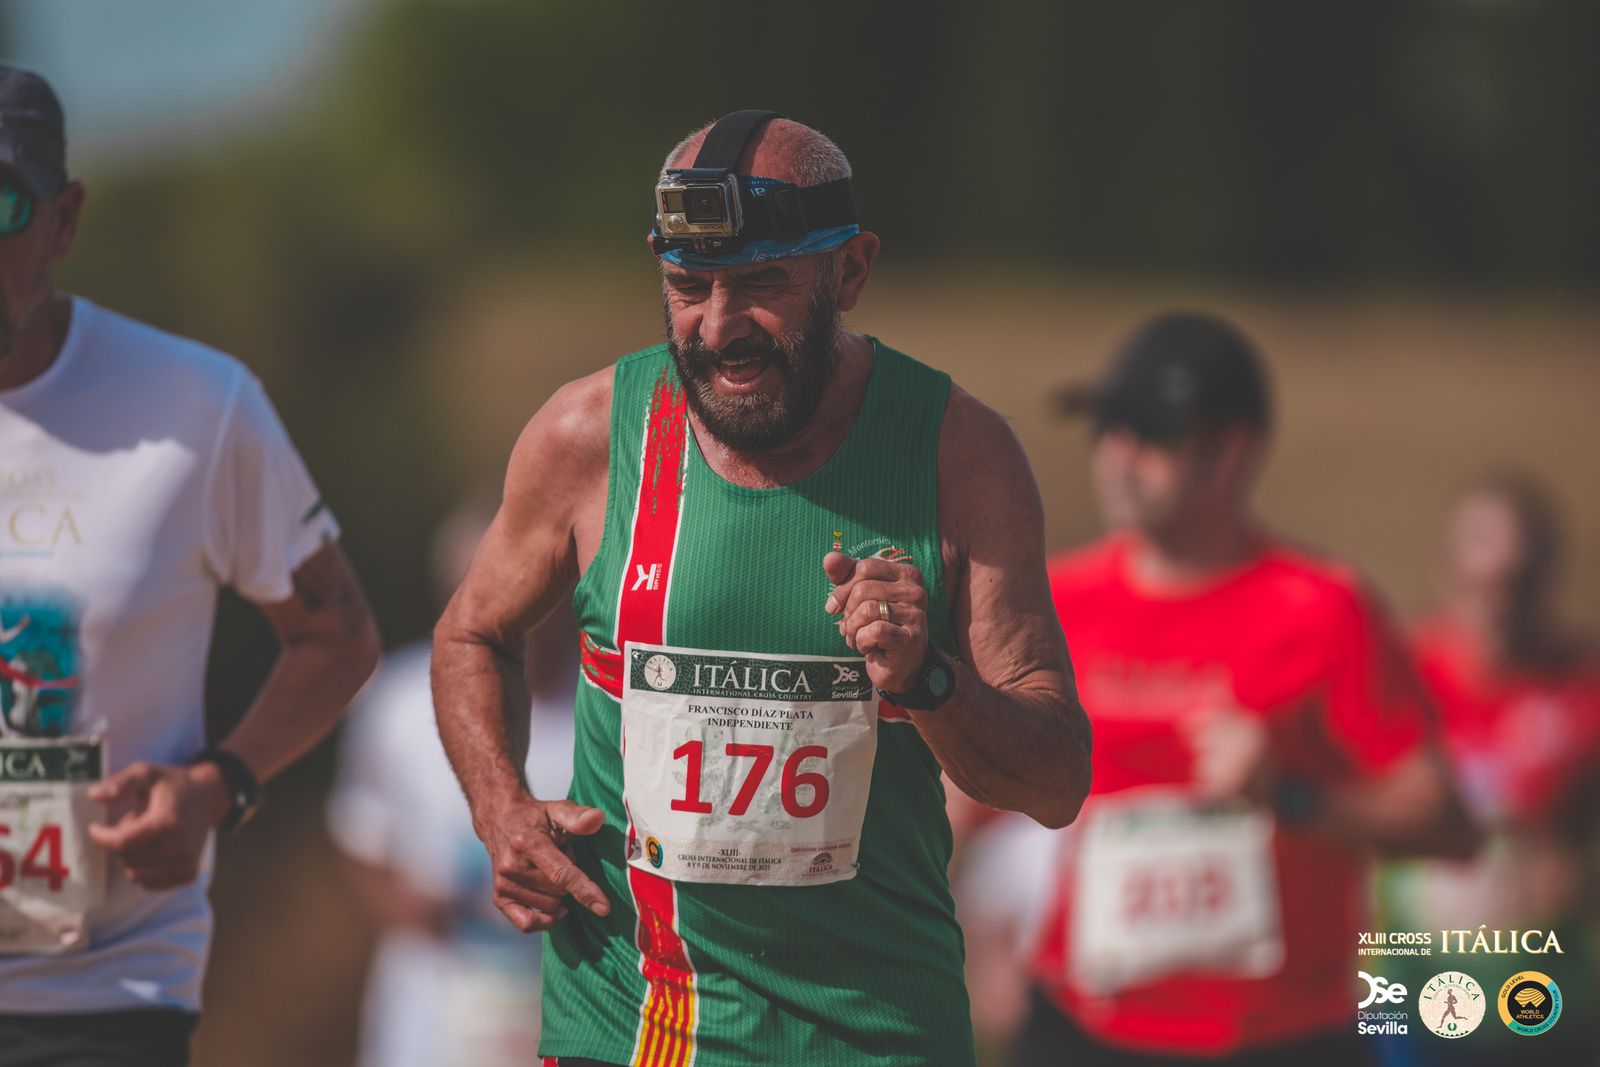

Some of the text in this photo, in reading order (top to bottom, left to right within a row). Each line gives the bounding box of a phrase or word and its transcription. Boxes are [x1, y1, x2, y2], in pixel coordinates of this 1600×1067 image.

[692, 660, 813, 694] ITÁLICA
[693, 688, 751, 697] INTERNATIONAL
[831, 689, 859, 699] Sevilla
[688, 704, 814, 720] FRANCISCO DÍAZ PLATA
[707, 717, 793, 731] INDEPENDIENTE
[670, 740, 830, 819] 176
[677, 854, 697, 862] CROSS
[698, 855, 747, 864] INTERNACIONAL
[711, 863, 747, 871] NOVIEMBRE
